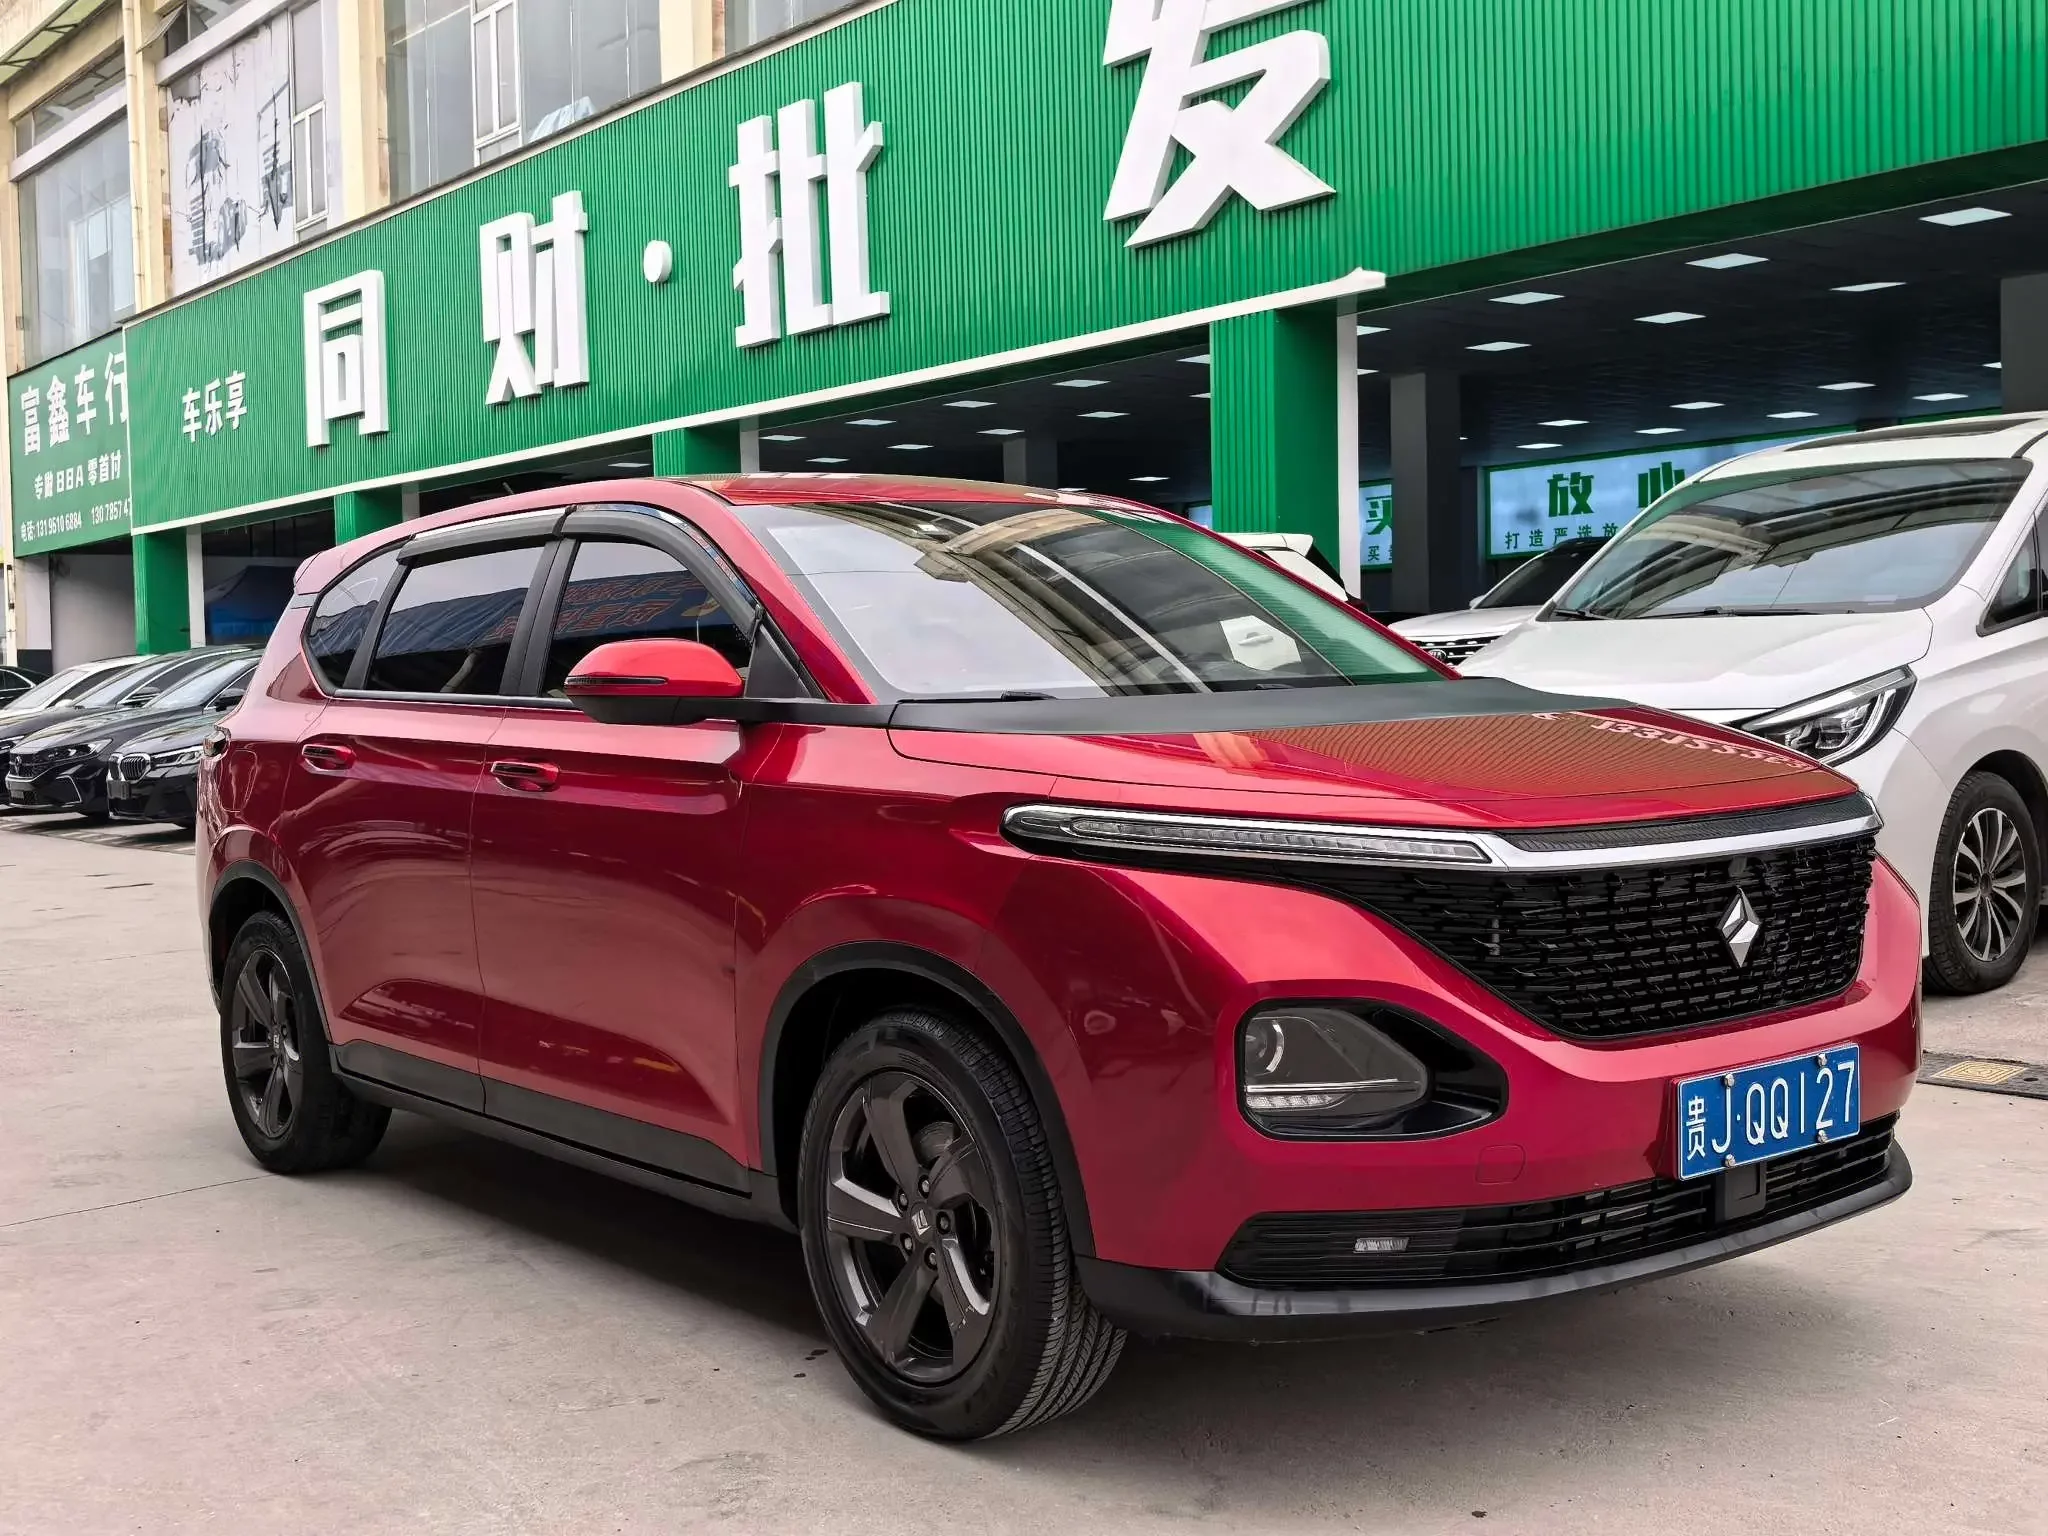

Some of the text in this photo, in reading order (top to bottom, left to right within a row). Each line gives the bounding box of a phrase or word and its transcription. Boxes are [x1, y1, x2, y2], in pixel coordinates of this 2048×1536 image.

[21, 351, 129, 456] 富鑫车行
[182, 370, 248, 443] 车乐享
